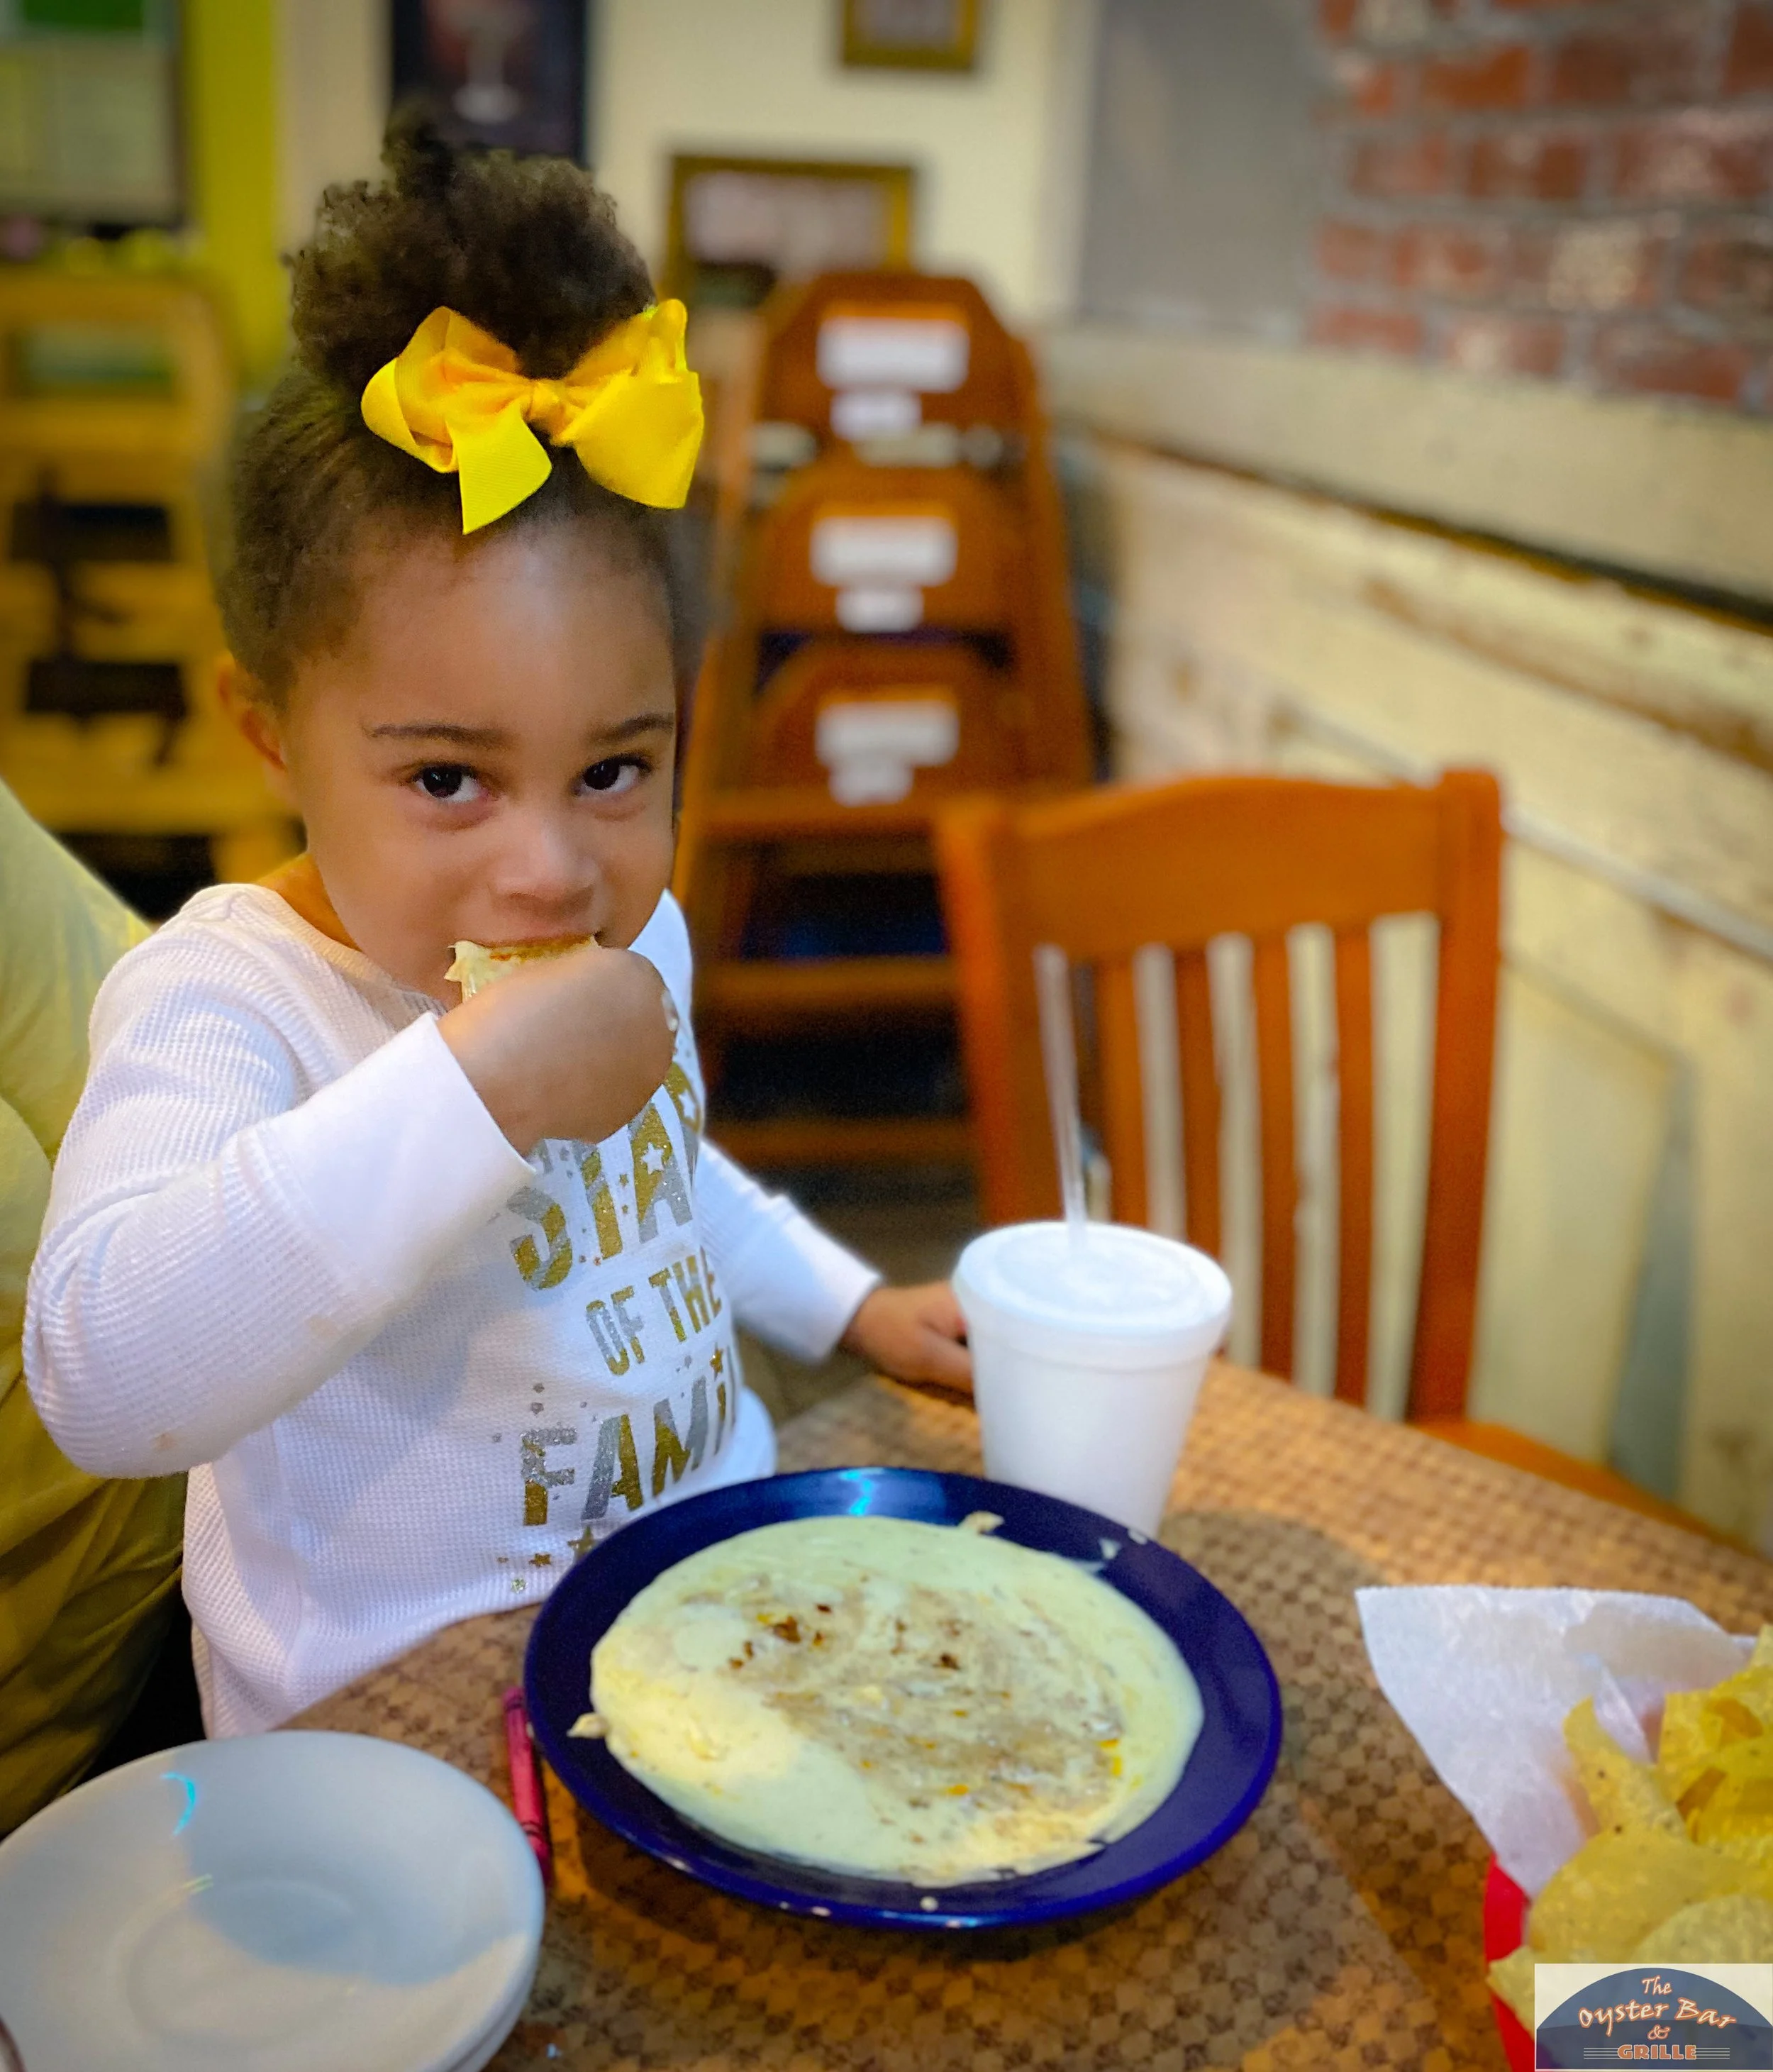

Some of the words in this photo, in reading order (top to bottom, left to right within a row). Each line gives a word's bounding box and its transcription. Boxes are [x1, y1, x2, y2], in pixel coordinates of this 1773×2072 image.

[586, 1285, 646, 1376] OF
[648, 1245, 722, 1343] THE
[520, 1345, 736, 1526] FAMI
